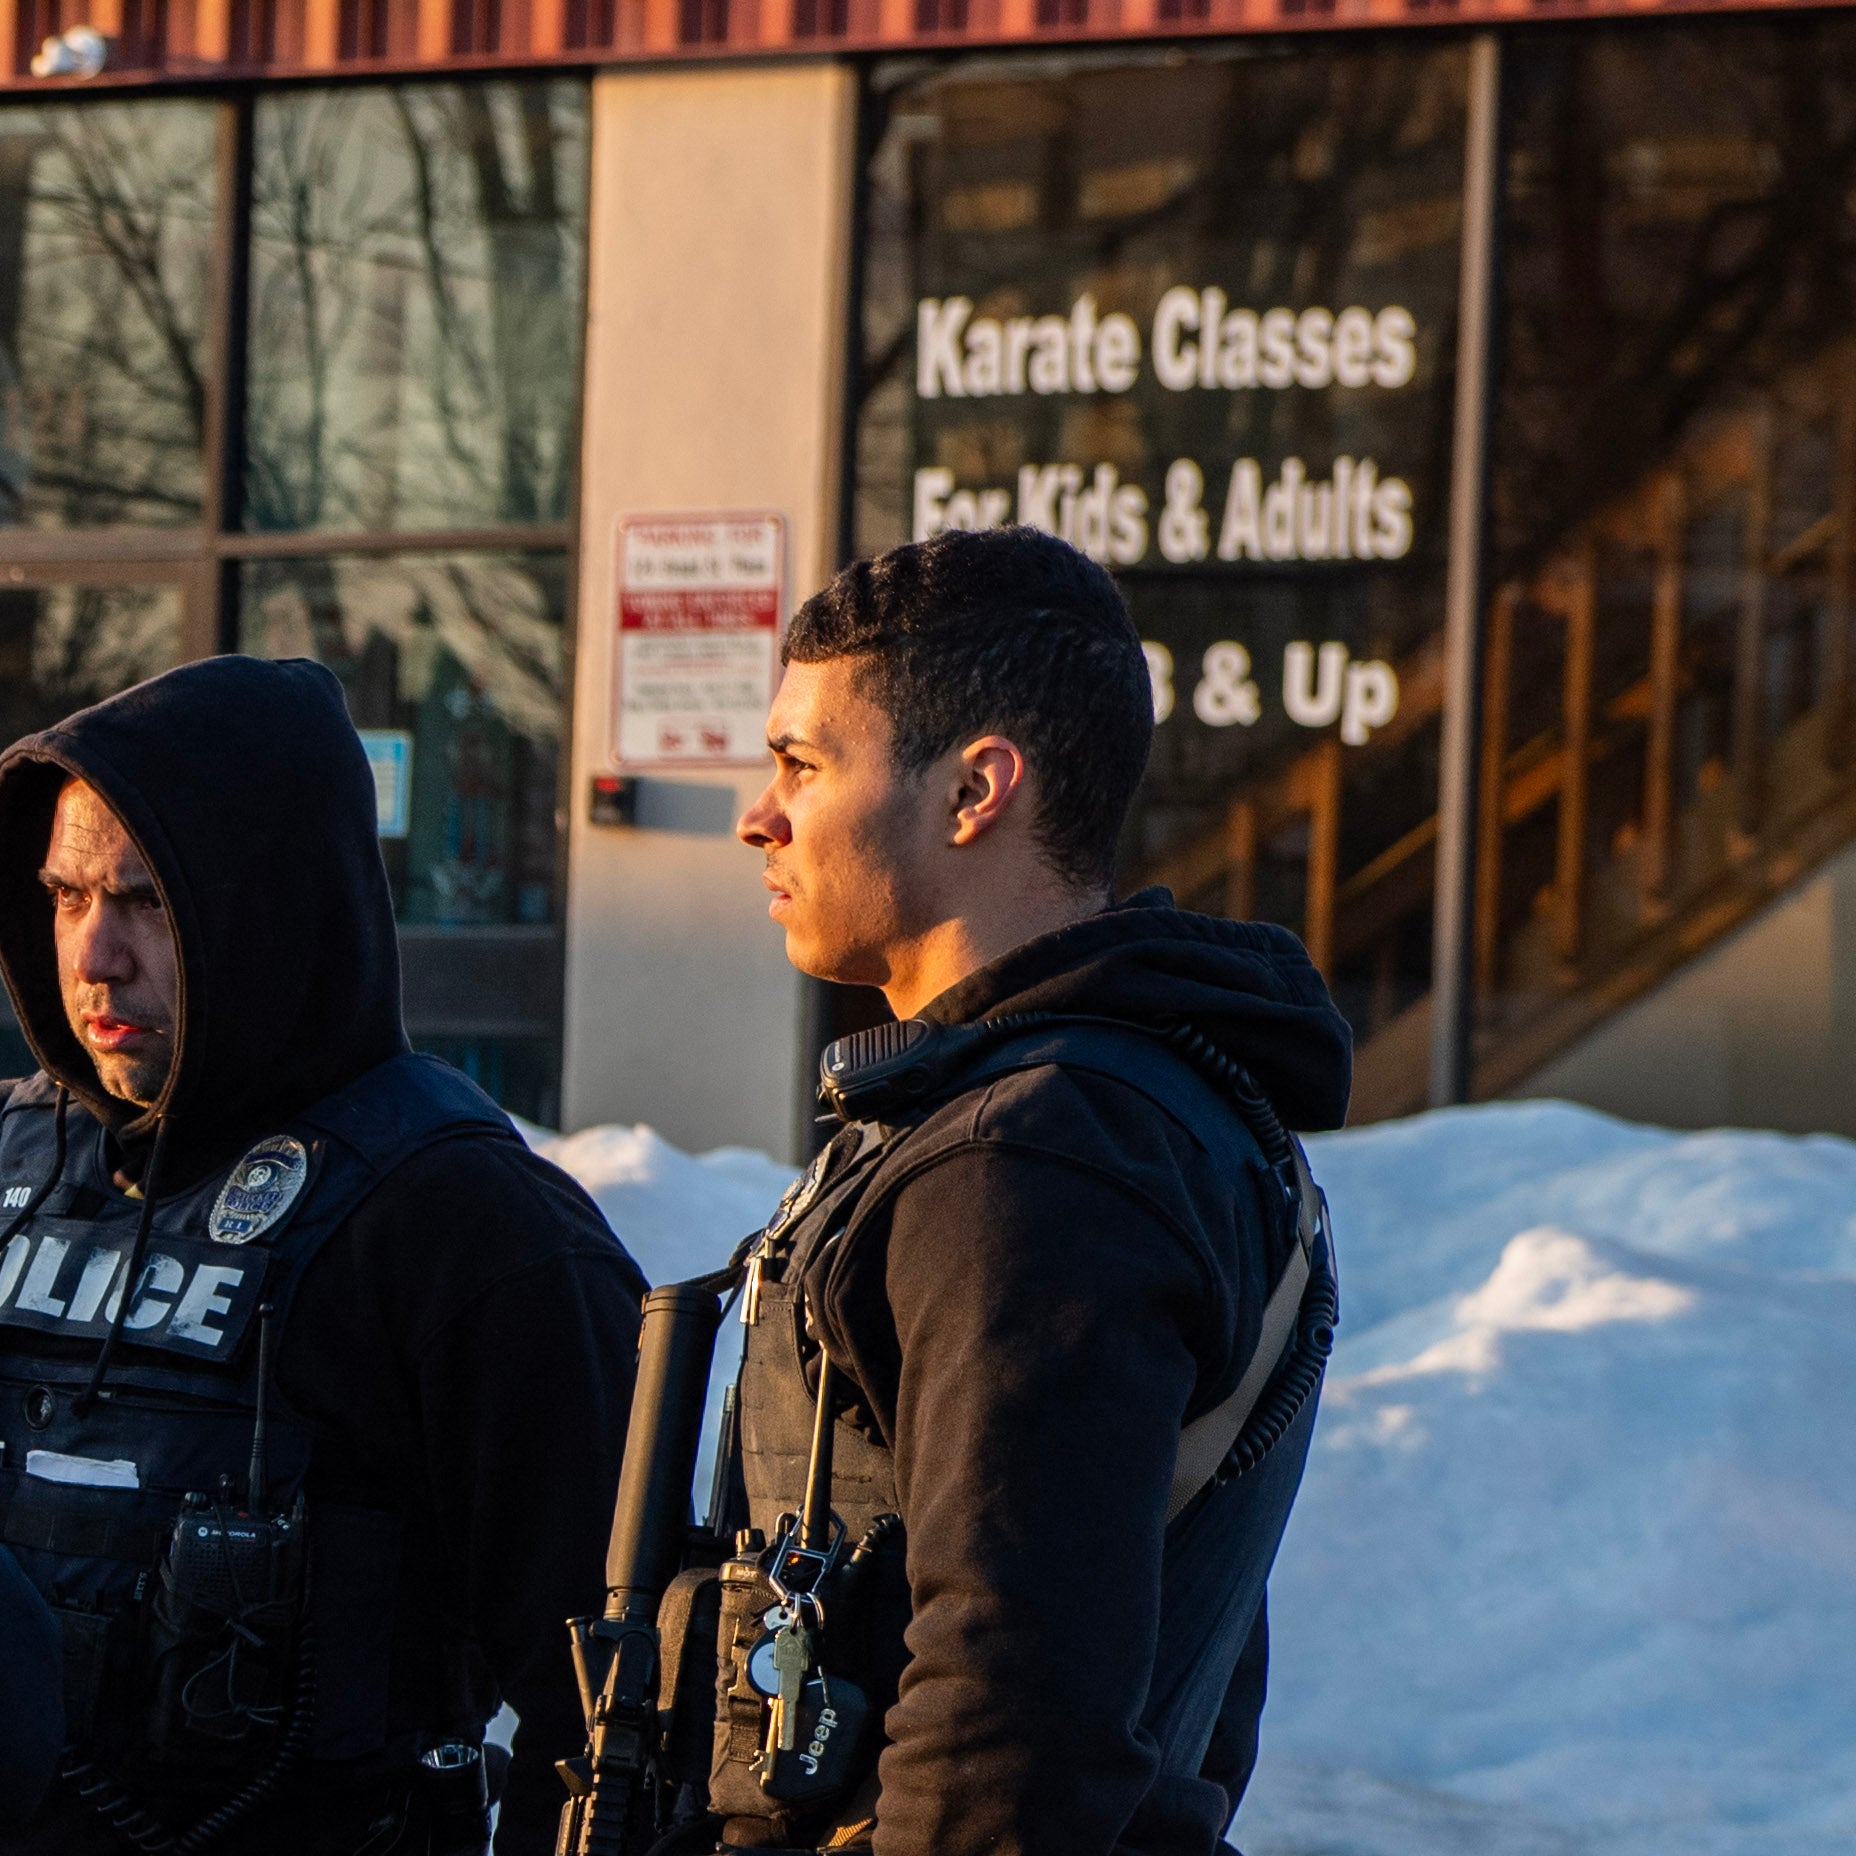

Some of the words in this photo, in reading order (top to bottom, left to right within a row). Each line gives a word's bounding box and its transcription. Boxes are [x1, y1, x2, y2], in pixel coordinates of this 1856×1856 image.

[916, 294, 1142, 398] Karate
[1152, 286, 1416, 391] Classes
[1018, 462, 1148, 565] Kids
[1158, 458, 1210, 563] &
[1217, 456, 1413, 562] Adults
[1193, 640, 1261, 727] &
[1283, 640, 1399, 746] Up
[2, 1186, 32, 1208] 140
[798, 1707, 839, 1776] Jeep
